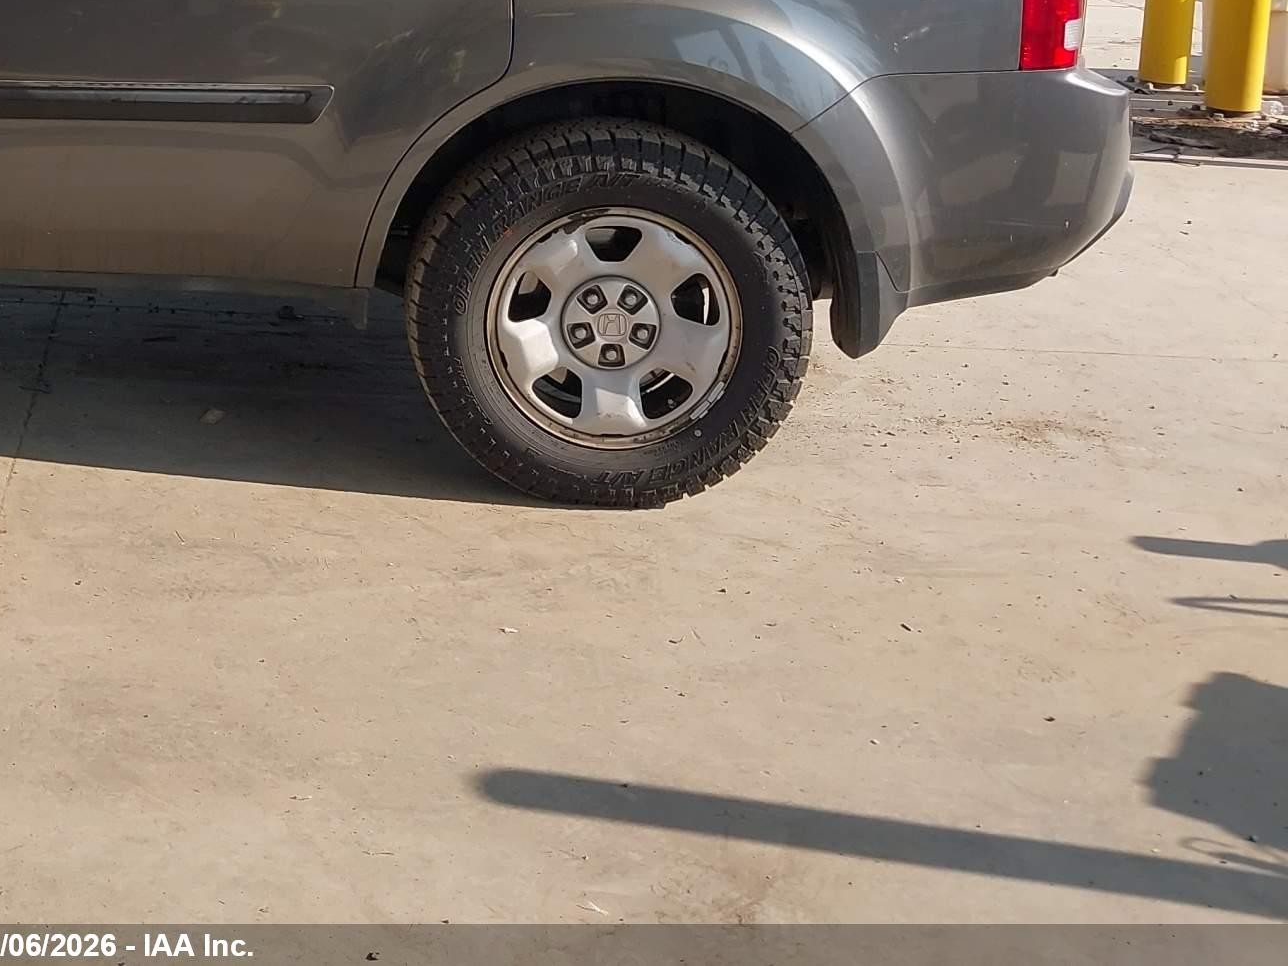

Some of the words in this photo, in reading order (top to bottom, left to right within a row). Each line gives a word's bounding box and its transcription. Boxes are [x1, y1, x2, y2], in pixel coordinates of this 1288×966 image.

[453, 232, 494, 315] OPEN
[488, 176, 585, 241] RANGE
[648, 418, 746, 482] RANGE
